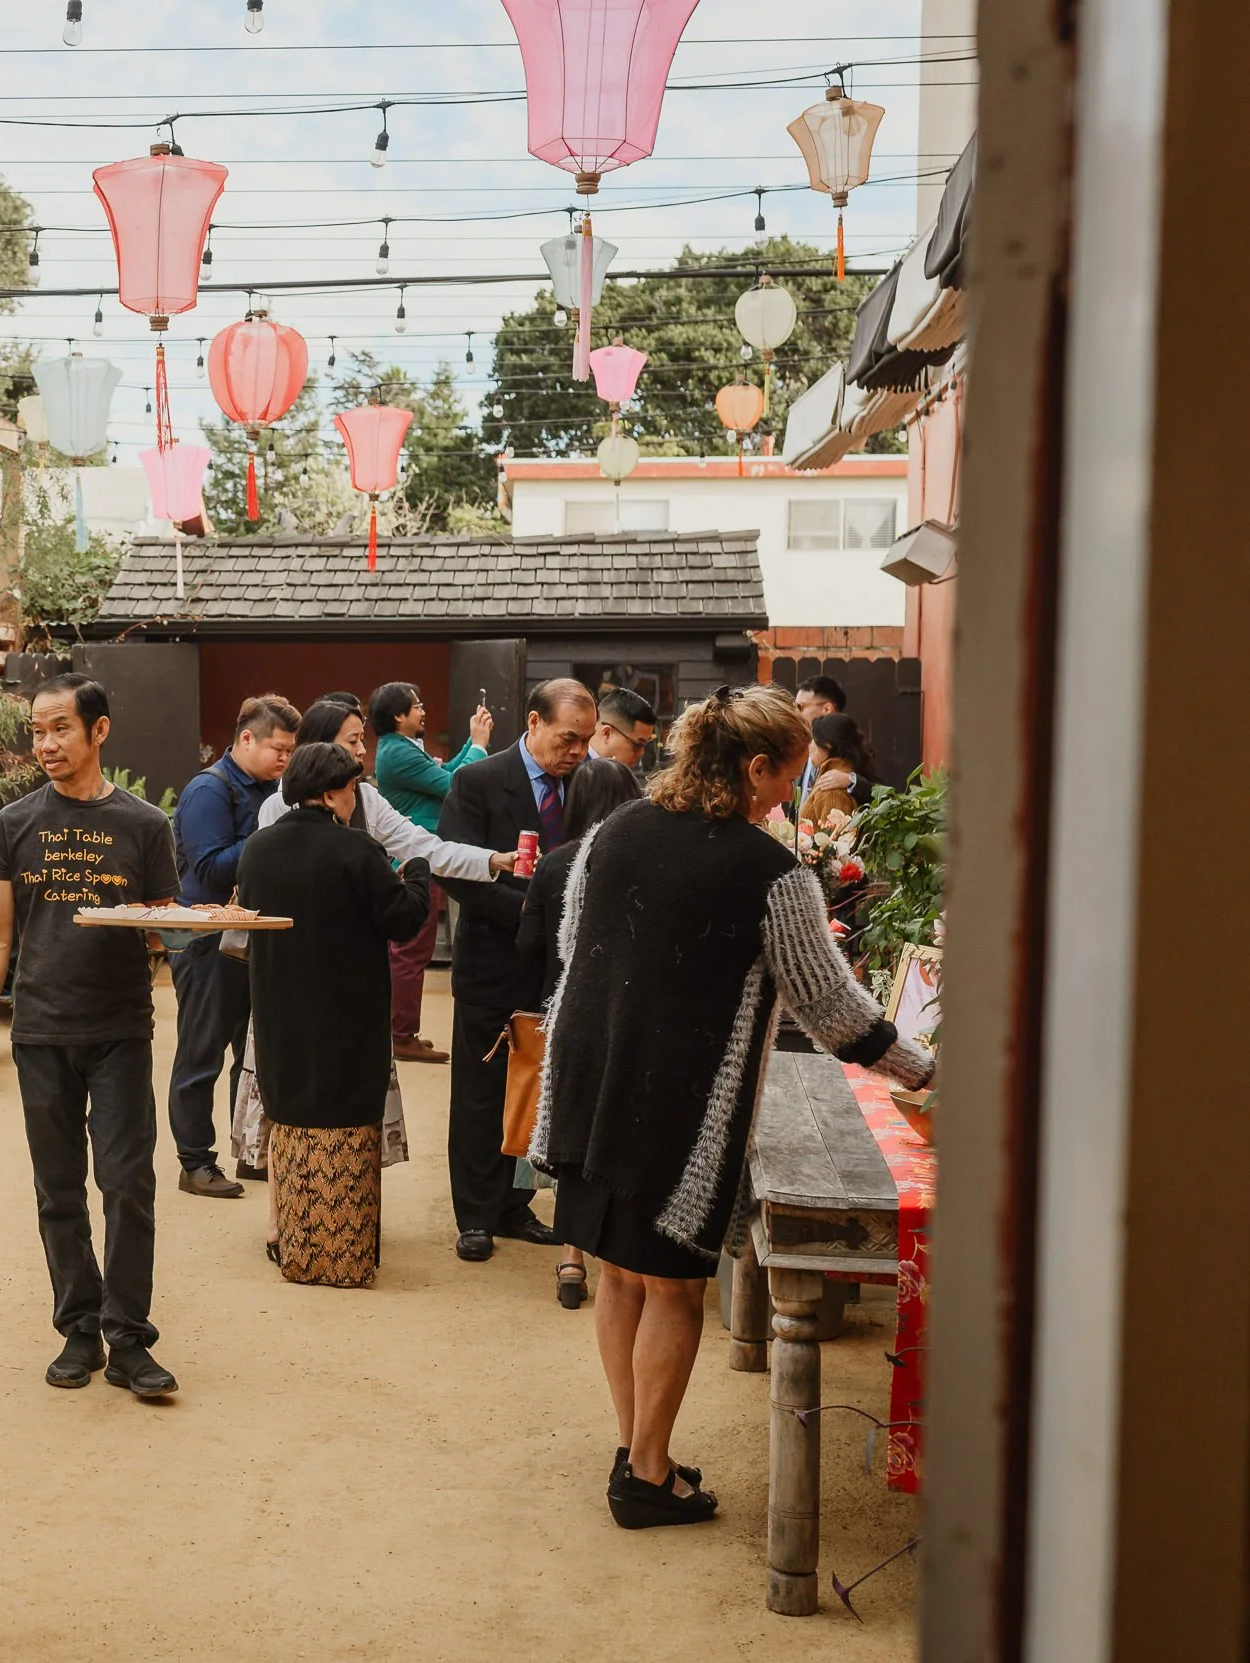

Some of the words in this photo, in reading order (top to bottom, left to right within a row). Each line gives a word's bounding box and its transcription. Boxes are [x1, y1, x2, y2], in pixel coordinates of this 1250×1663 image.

[38, 828, 69, 843] Thai
[73, 829, 113, 845] Table
[44, 848, 104, 865] berkeley
[20, 868, 48, 885] Thai
[52, 867, 81, 881] Rice
[44, 887, 101, 905] Catering
